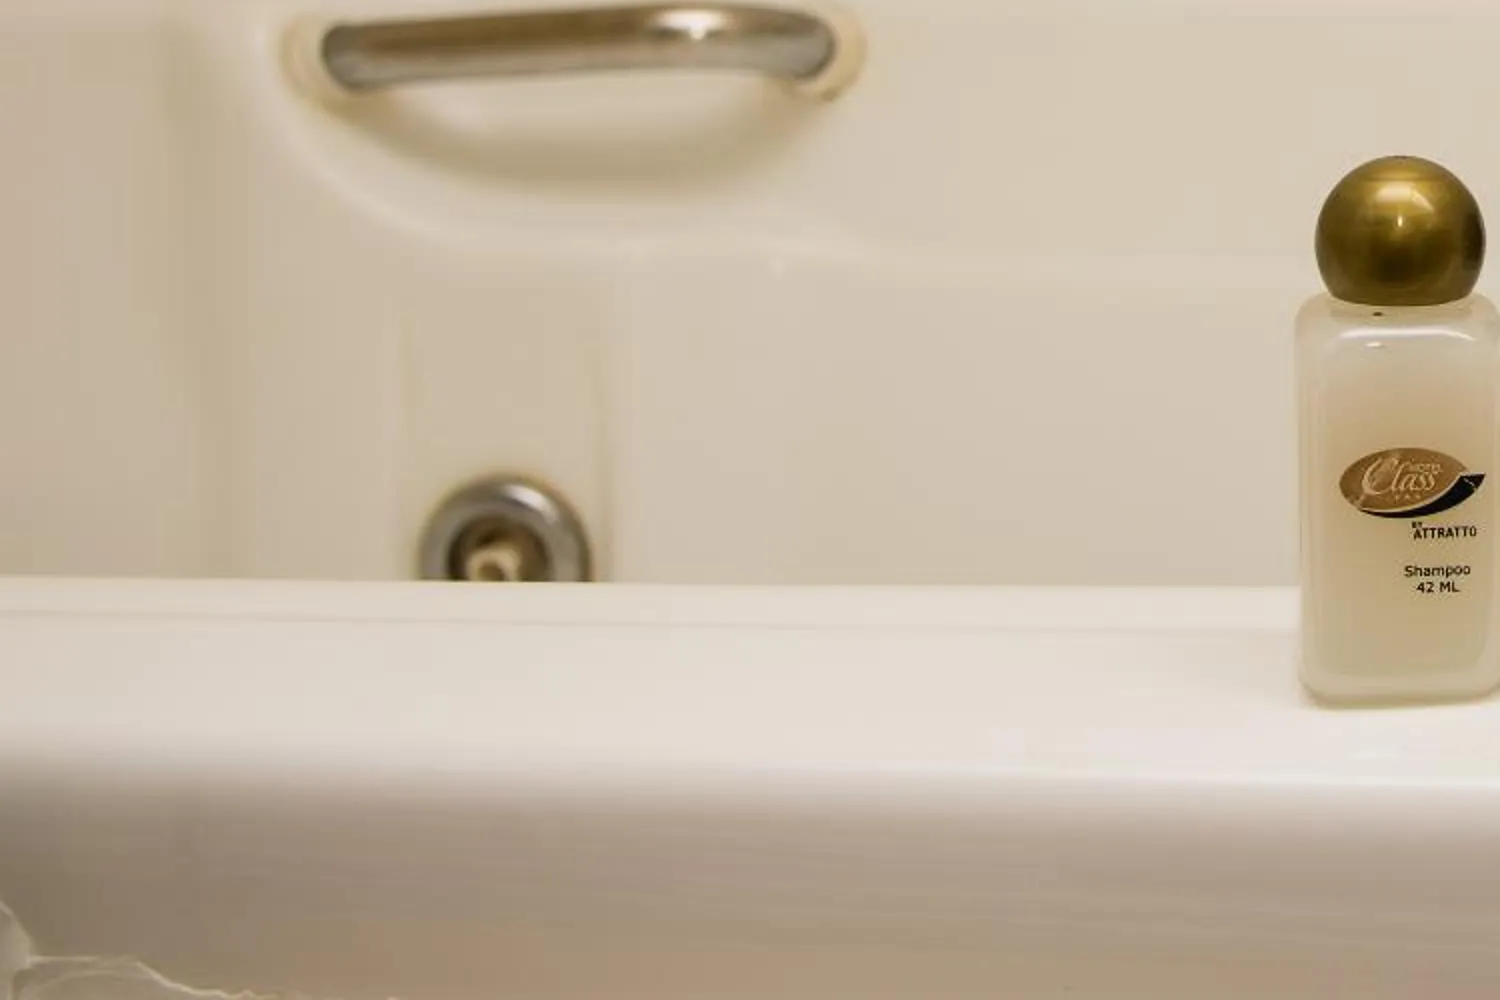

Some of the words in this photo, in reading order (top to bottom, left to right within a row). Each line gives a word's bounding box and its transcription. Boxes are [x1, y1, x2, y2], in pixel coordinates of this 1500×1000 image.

[1362, 457, 1436, 495] Class
[1413, 525, 1477, 540] ATTRATTO
[1404, 564, 1471, 579] Shampoo
[1416, 581, 1434, 593] 42
[1439, 580, 1460, 593] ML
